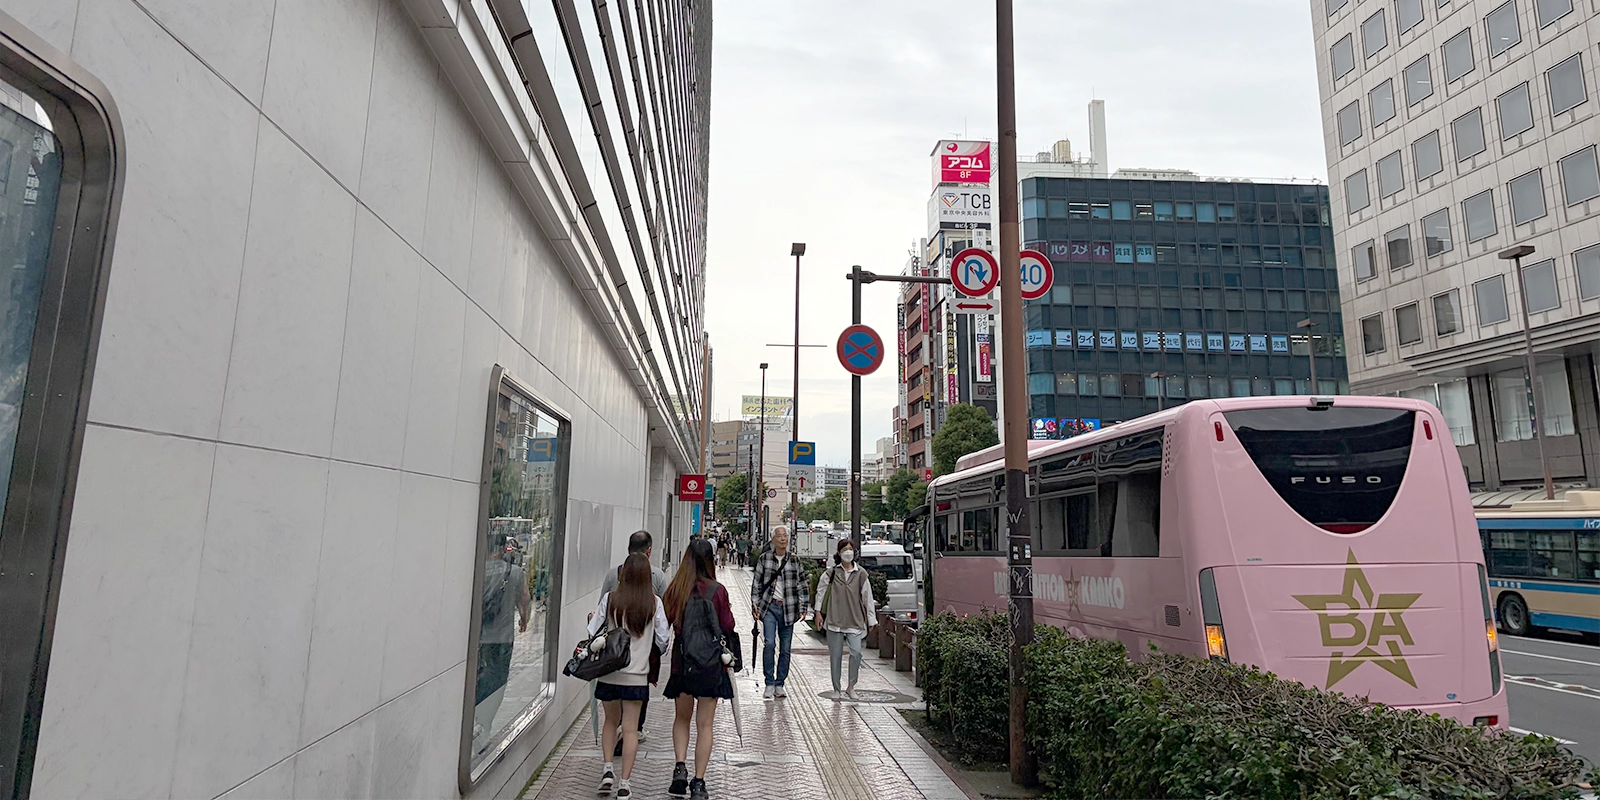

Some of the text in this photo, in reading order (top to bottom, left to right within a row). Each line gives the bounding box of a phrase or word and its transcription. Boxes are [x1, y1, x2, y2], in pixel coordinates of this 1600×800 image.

[947, 156, 984, 169] アコム
[959, 170, 972, 179] 8F
[960, 193, 991, 209] TCB
[1050, 244, 1153, 257] ハウスメイト 賃貸 売買
[1020, 264, 1043, 285] 40
[793, 443, 813, 462] P
[1290, 476, 1382, 484] FUSO
[1317, 593, 1415, 647] BA
